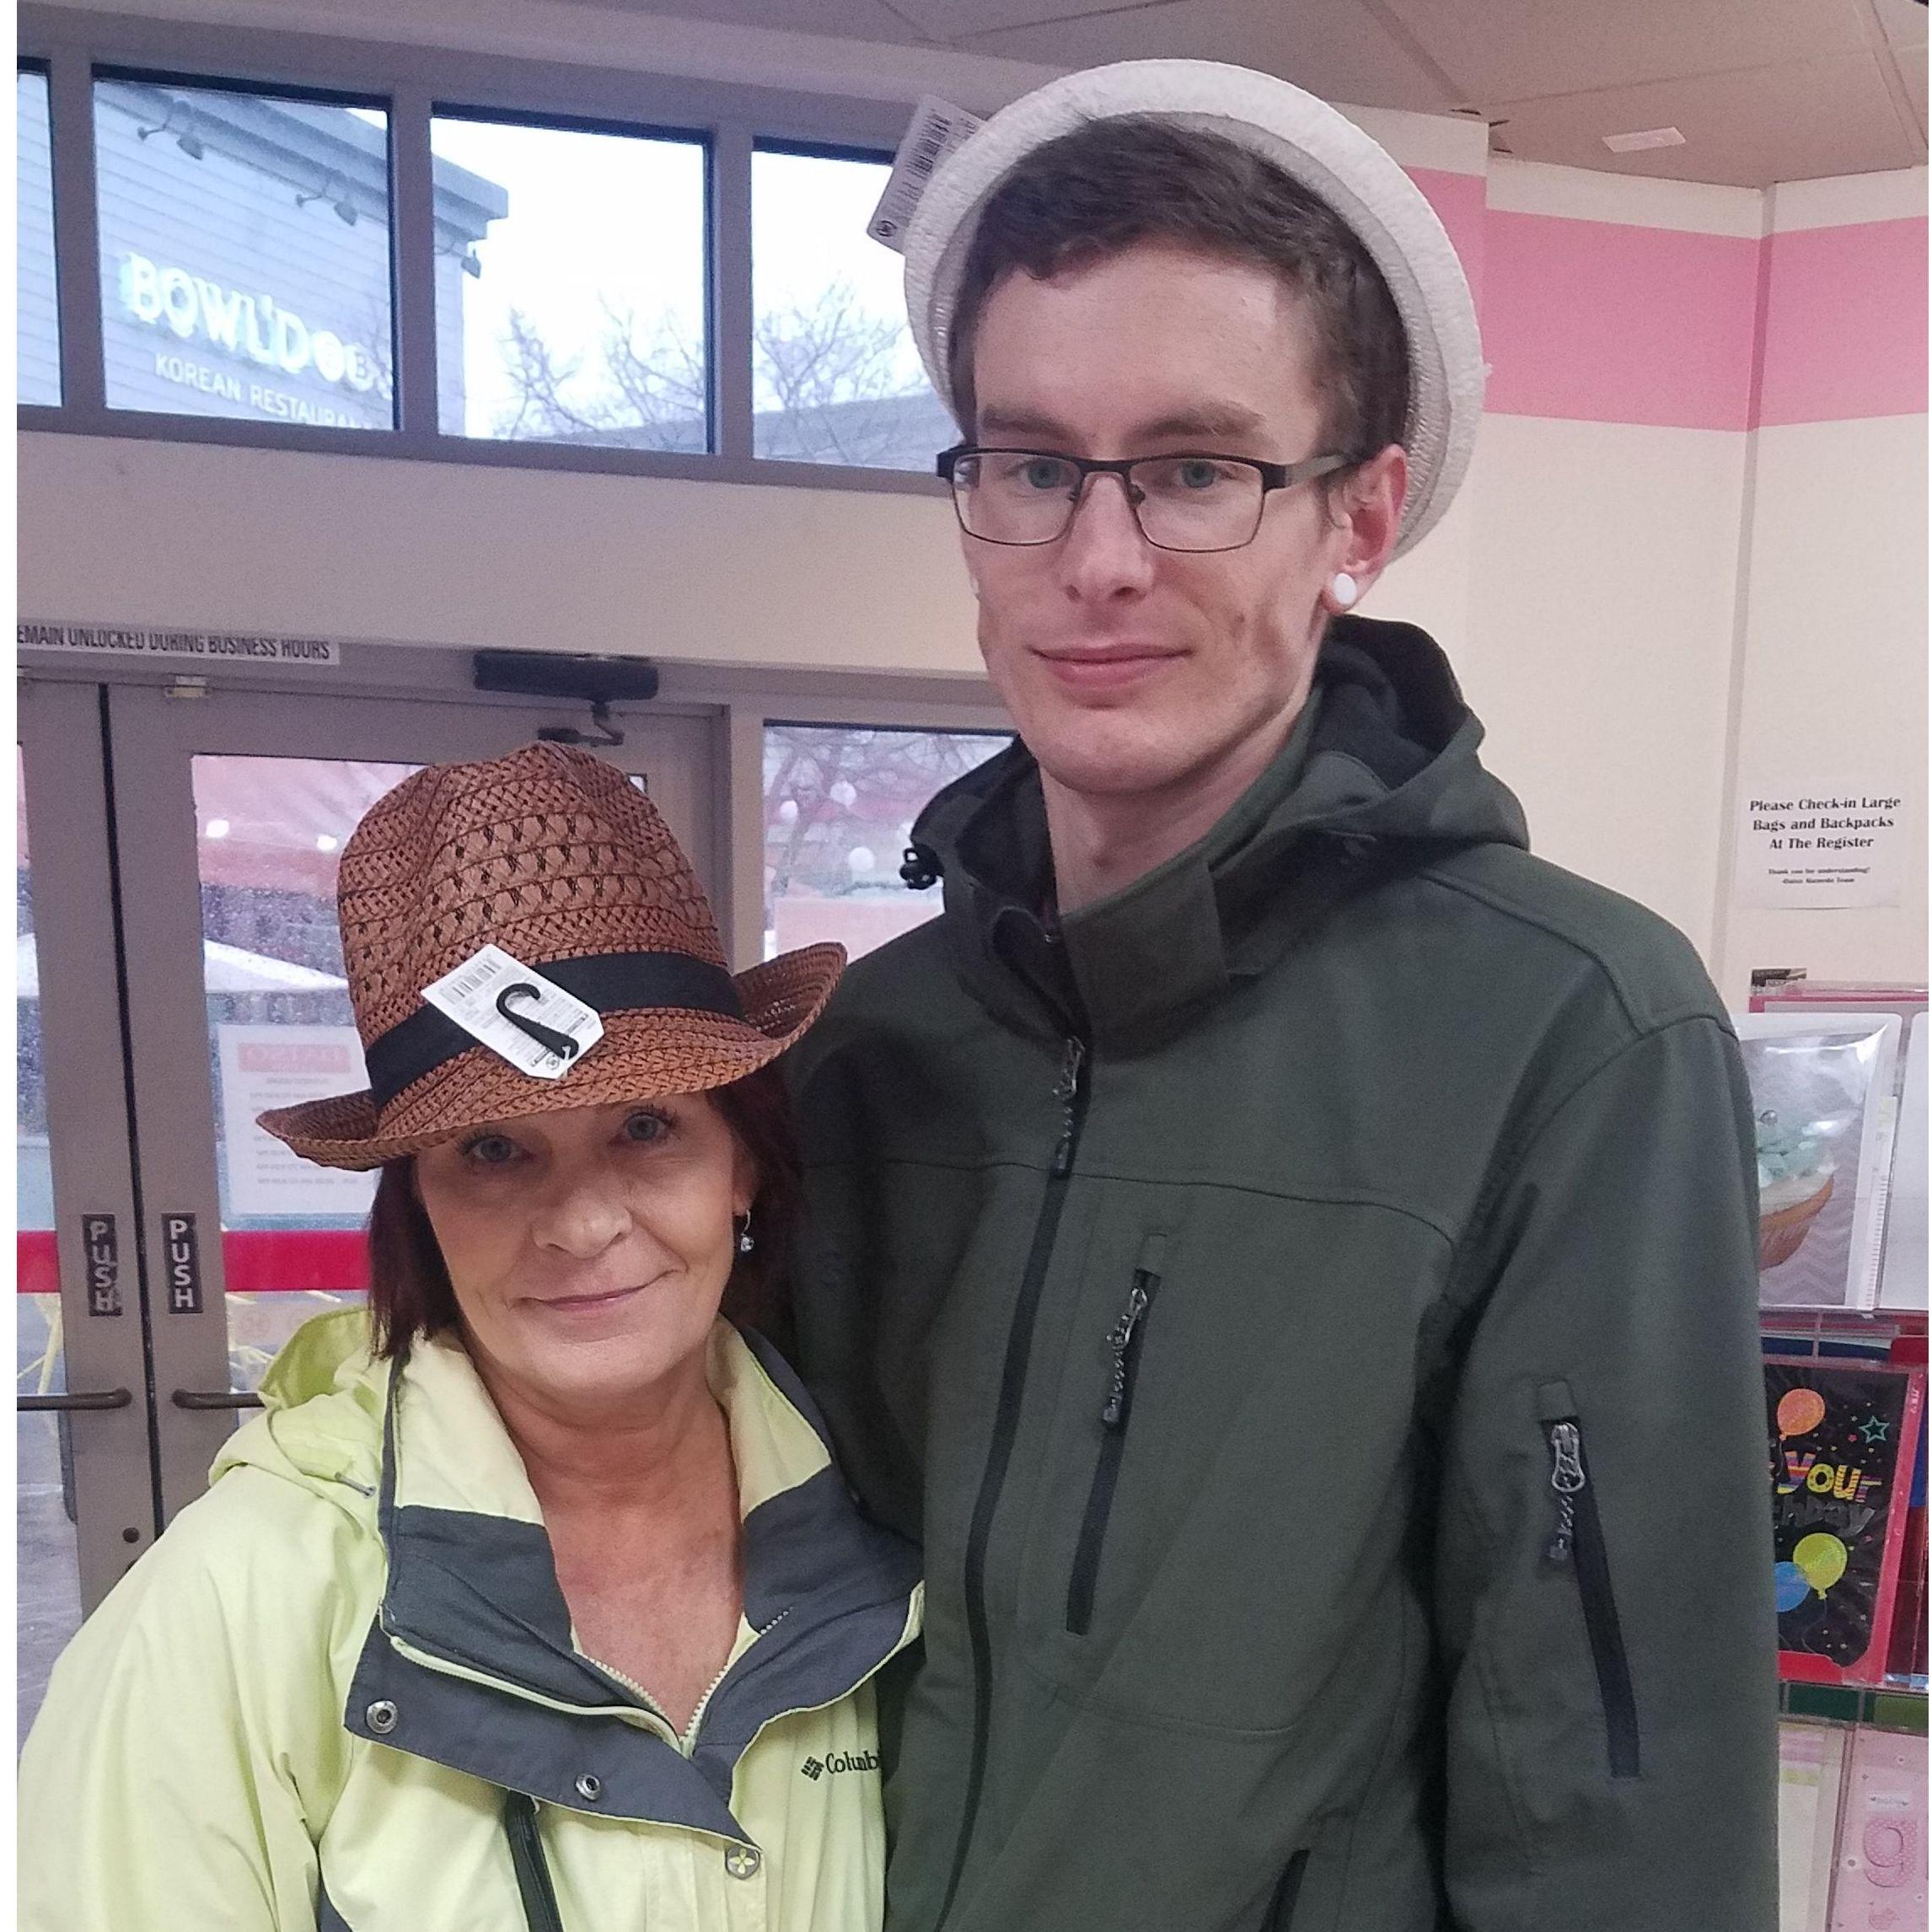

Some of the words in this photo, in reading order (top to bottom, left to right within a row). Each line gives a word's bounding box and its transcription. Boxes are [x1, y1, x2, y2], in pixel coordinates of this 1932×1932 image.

[155, 352, 241, 401] KOREAN
[250, 385, 372, 427] RESTAURA
[67, 628, 144, 650] UNLOCKED
[149, 632, 204, 652] DURING
[208, 635, 276, 657] BUSINESS
[281, 638, 330, 660] HOURS
[1750, 800, 1794, 811] Please
[1799, 797, 1856, 810] Check-in
[1862, 797, 1902, 809] Large
[1752, 819, 1785, 832] Bags
[1790, 818, 1816, 830] and
[1821, 816, 1894, 830] Backpacks
[1770, 838, 1783, 849] At
[1789, 838, 1812, 849] The
[1817, 836, 1874, 850] Register
[89, 1221, 115, 1312] PUSH
[169, 1219, 194, 1308] PUSH
